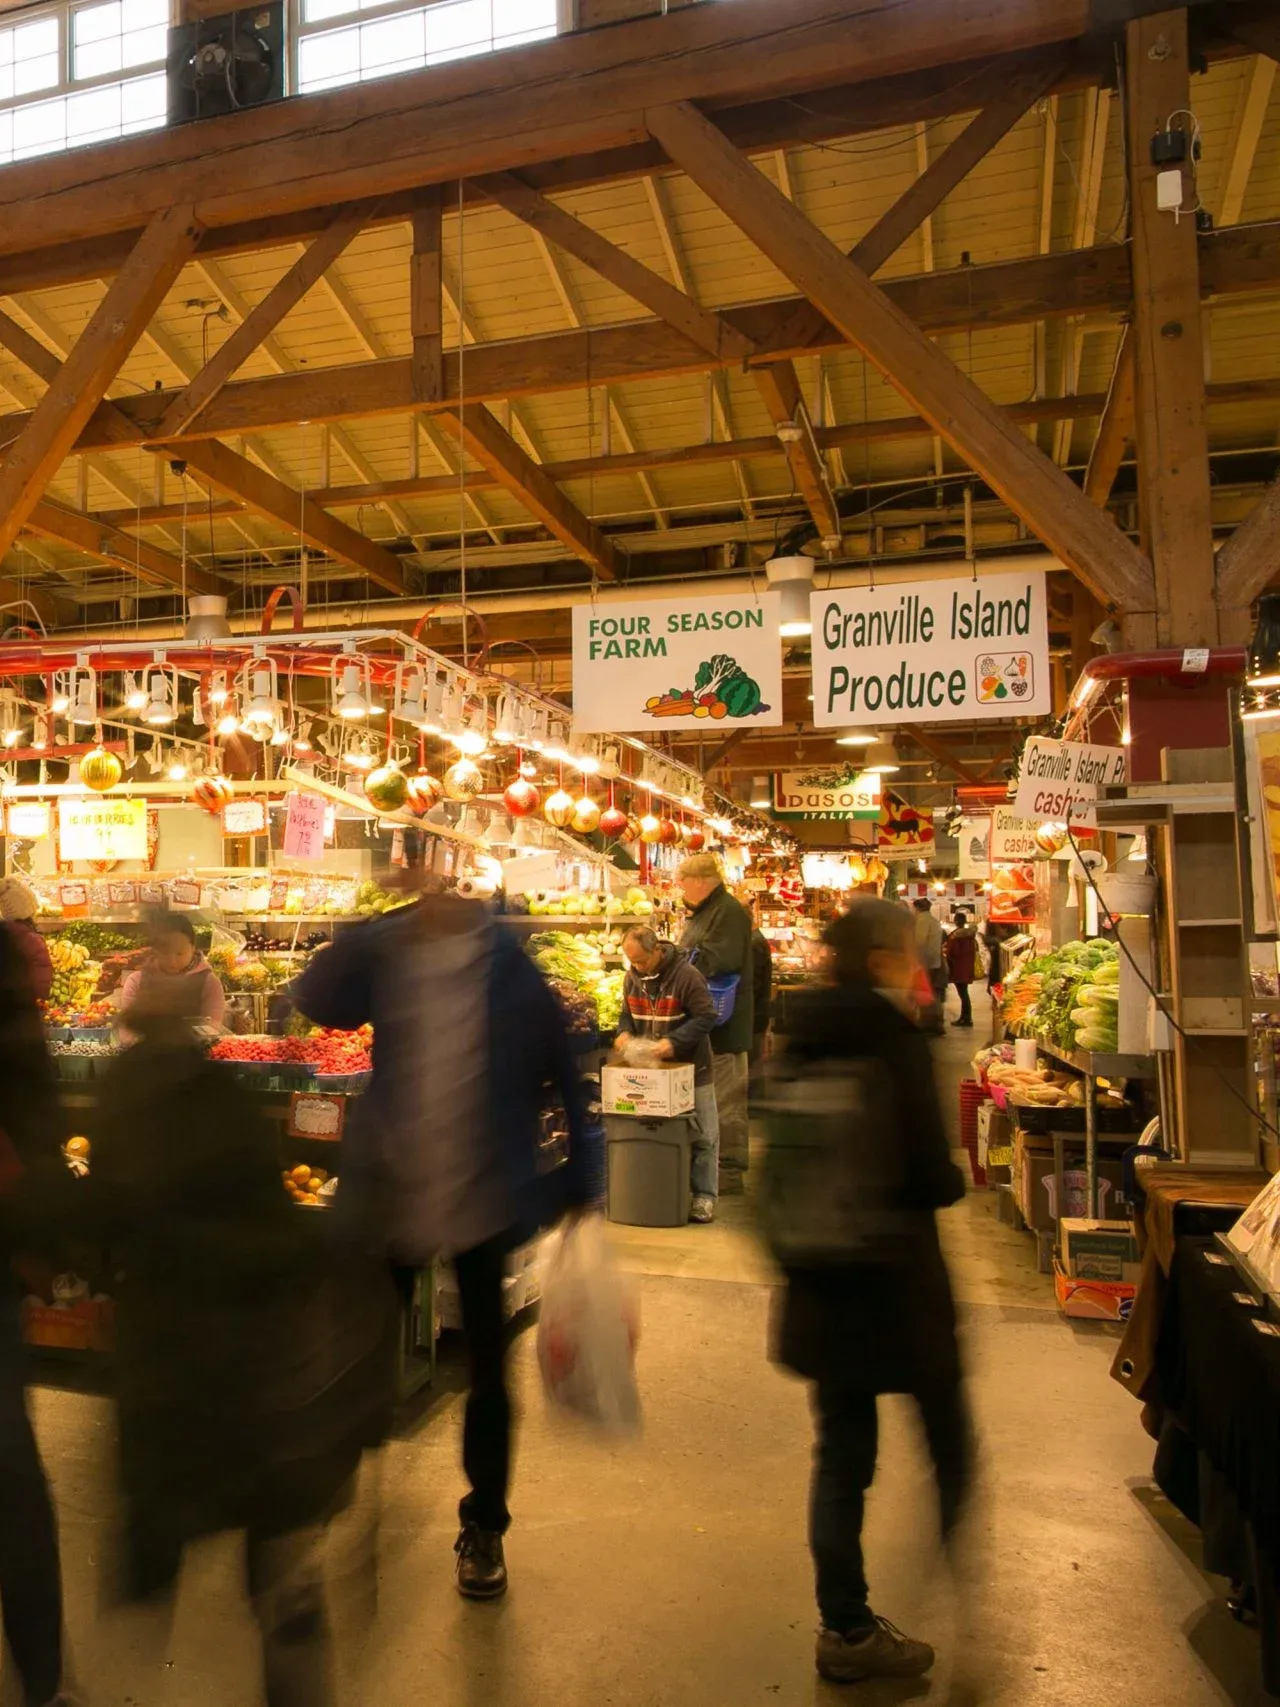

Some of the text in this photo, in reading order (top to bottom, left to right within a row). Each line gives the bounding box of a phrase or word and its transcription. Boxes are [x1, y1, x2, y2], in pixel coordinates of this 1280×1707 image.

[588, 608, 763, 638] FOUR SEASON
[823, 585, 1032, 651] Granville Island
[588, 636, 668, 661] FARM
[827, 660, 967, 714] Produce
[1027, 744, 1072, 783] Granville
[1075, 750, 1110, 785] Island
[803, 811, 855, 820] ITALIA
